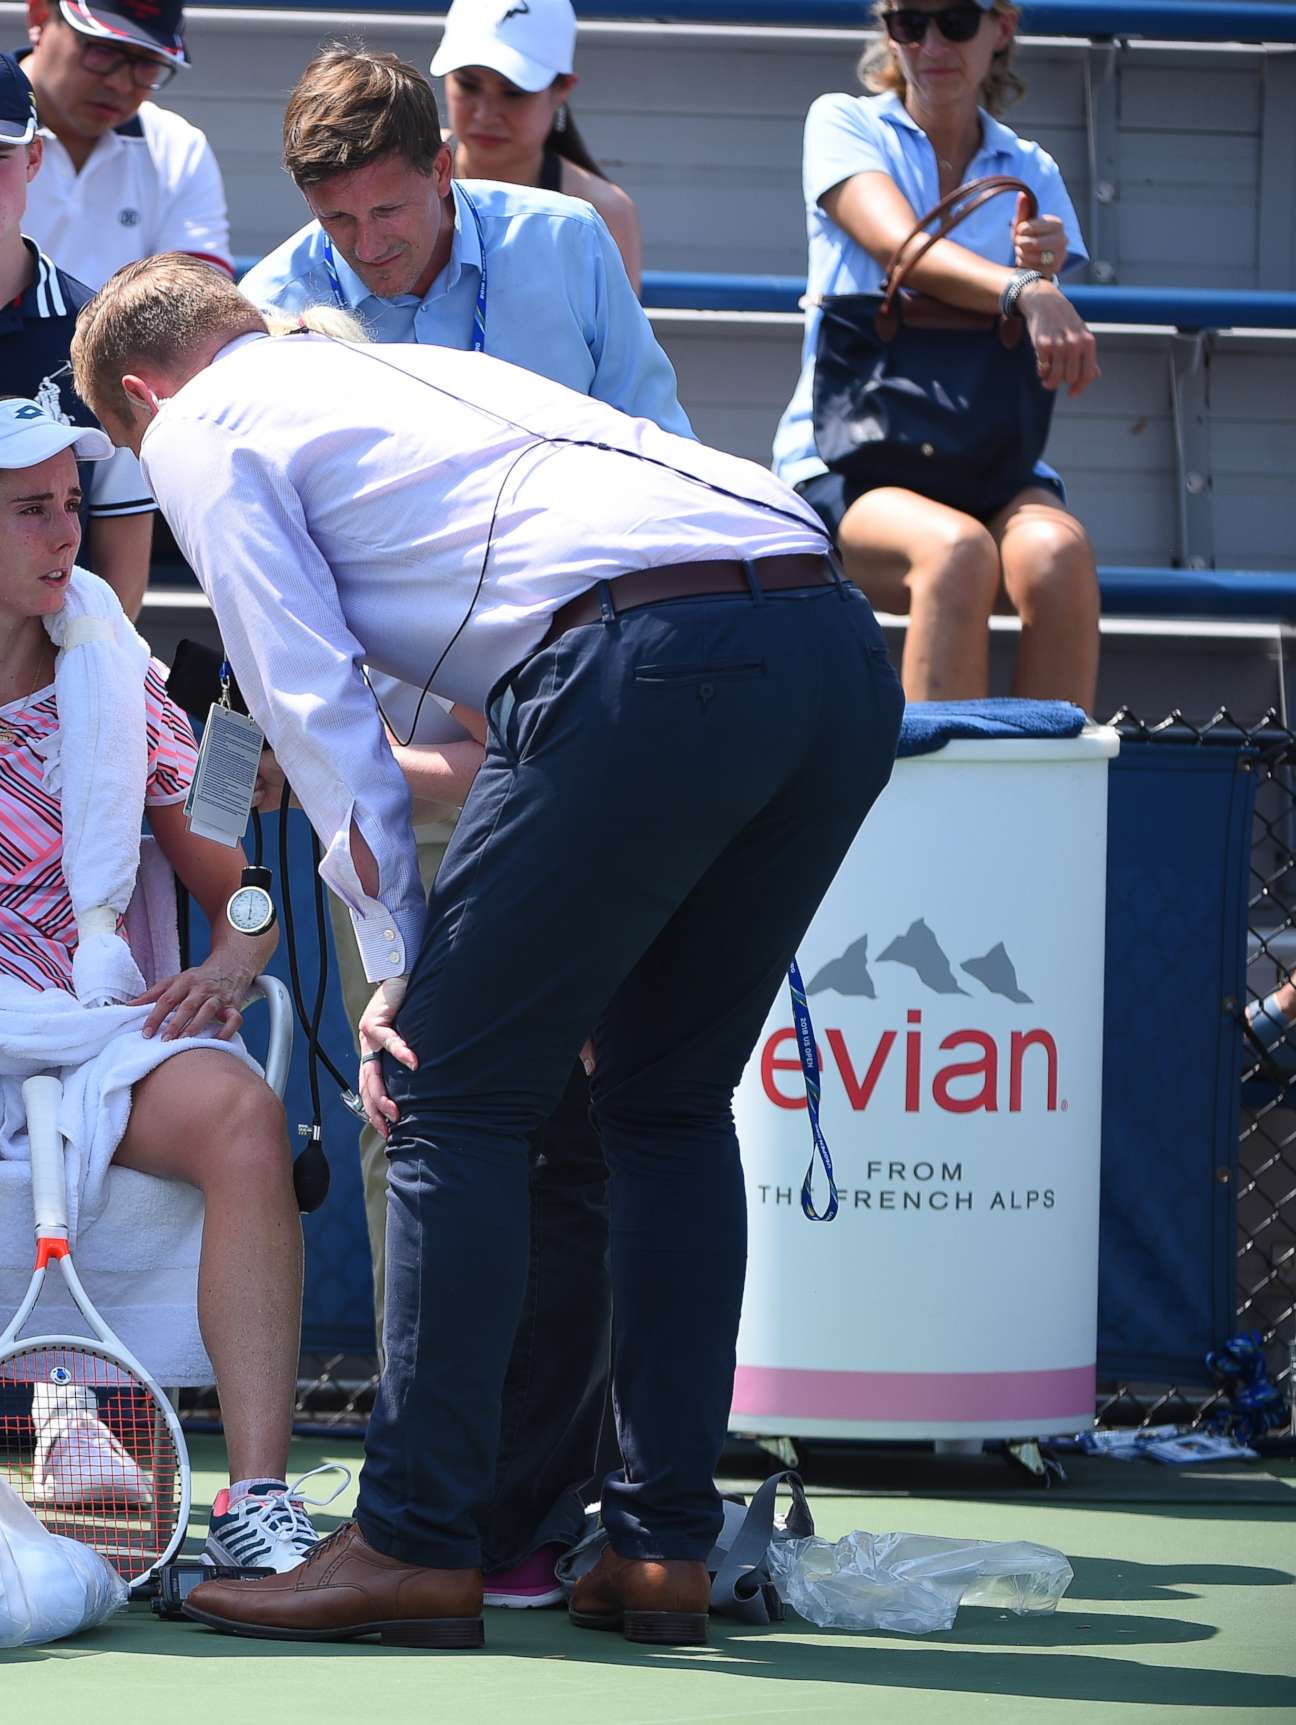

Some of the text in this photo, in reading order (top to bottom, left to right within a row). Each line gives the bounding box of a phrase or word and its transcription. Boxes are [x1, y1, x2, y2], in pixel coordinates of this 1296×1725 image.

[761, 1009, 1058, 1114] evian
[800, 1018, 809, 1036] 2018
[805, 1047, 813, 1068] OPEN
[867, 1161, 963, 1181] FROM
[758, 1185, 814, 1205] TH
[990, 1189, 1055, 1210] ALPS
